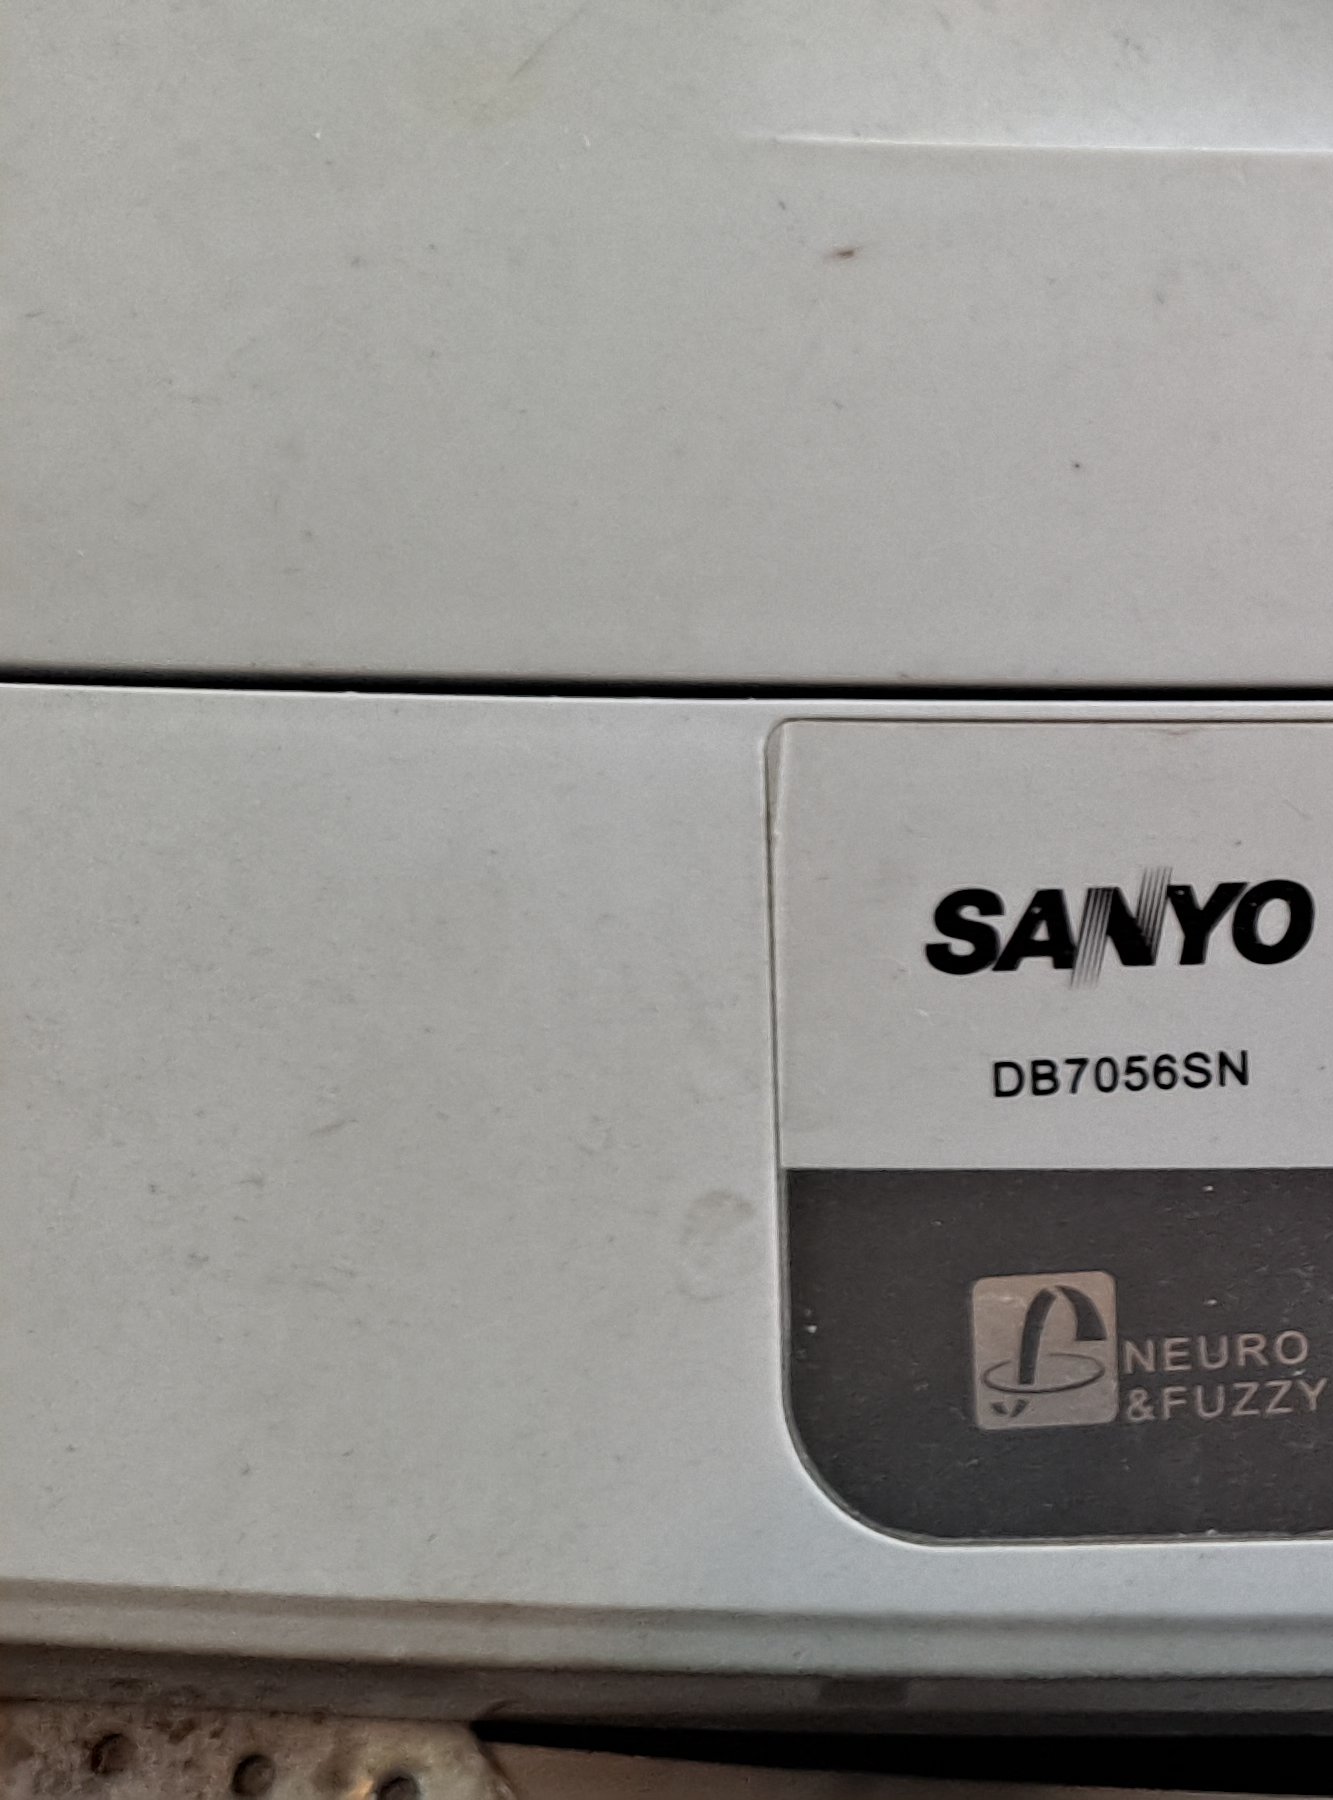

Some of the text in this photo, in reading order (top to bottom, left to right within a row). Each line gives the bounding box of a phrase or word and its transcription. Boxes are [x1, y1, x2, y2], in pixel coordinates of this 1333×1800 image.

[925, 868, 1315, 986] SANYO
[994, 1051, 1248, 1097] DB7056SN
[1126, 1331, 1307, 1375] NEURO
[1127, 1379, 1326, 1422] &FUZZY
